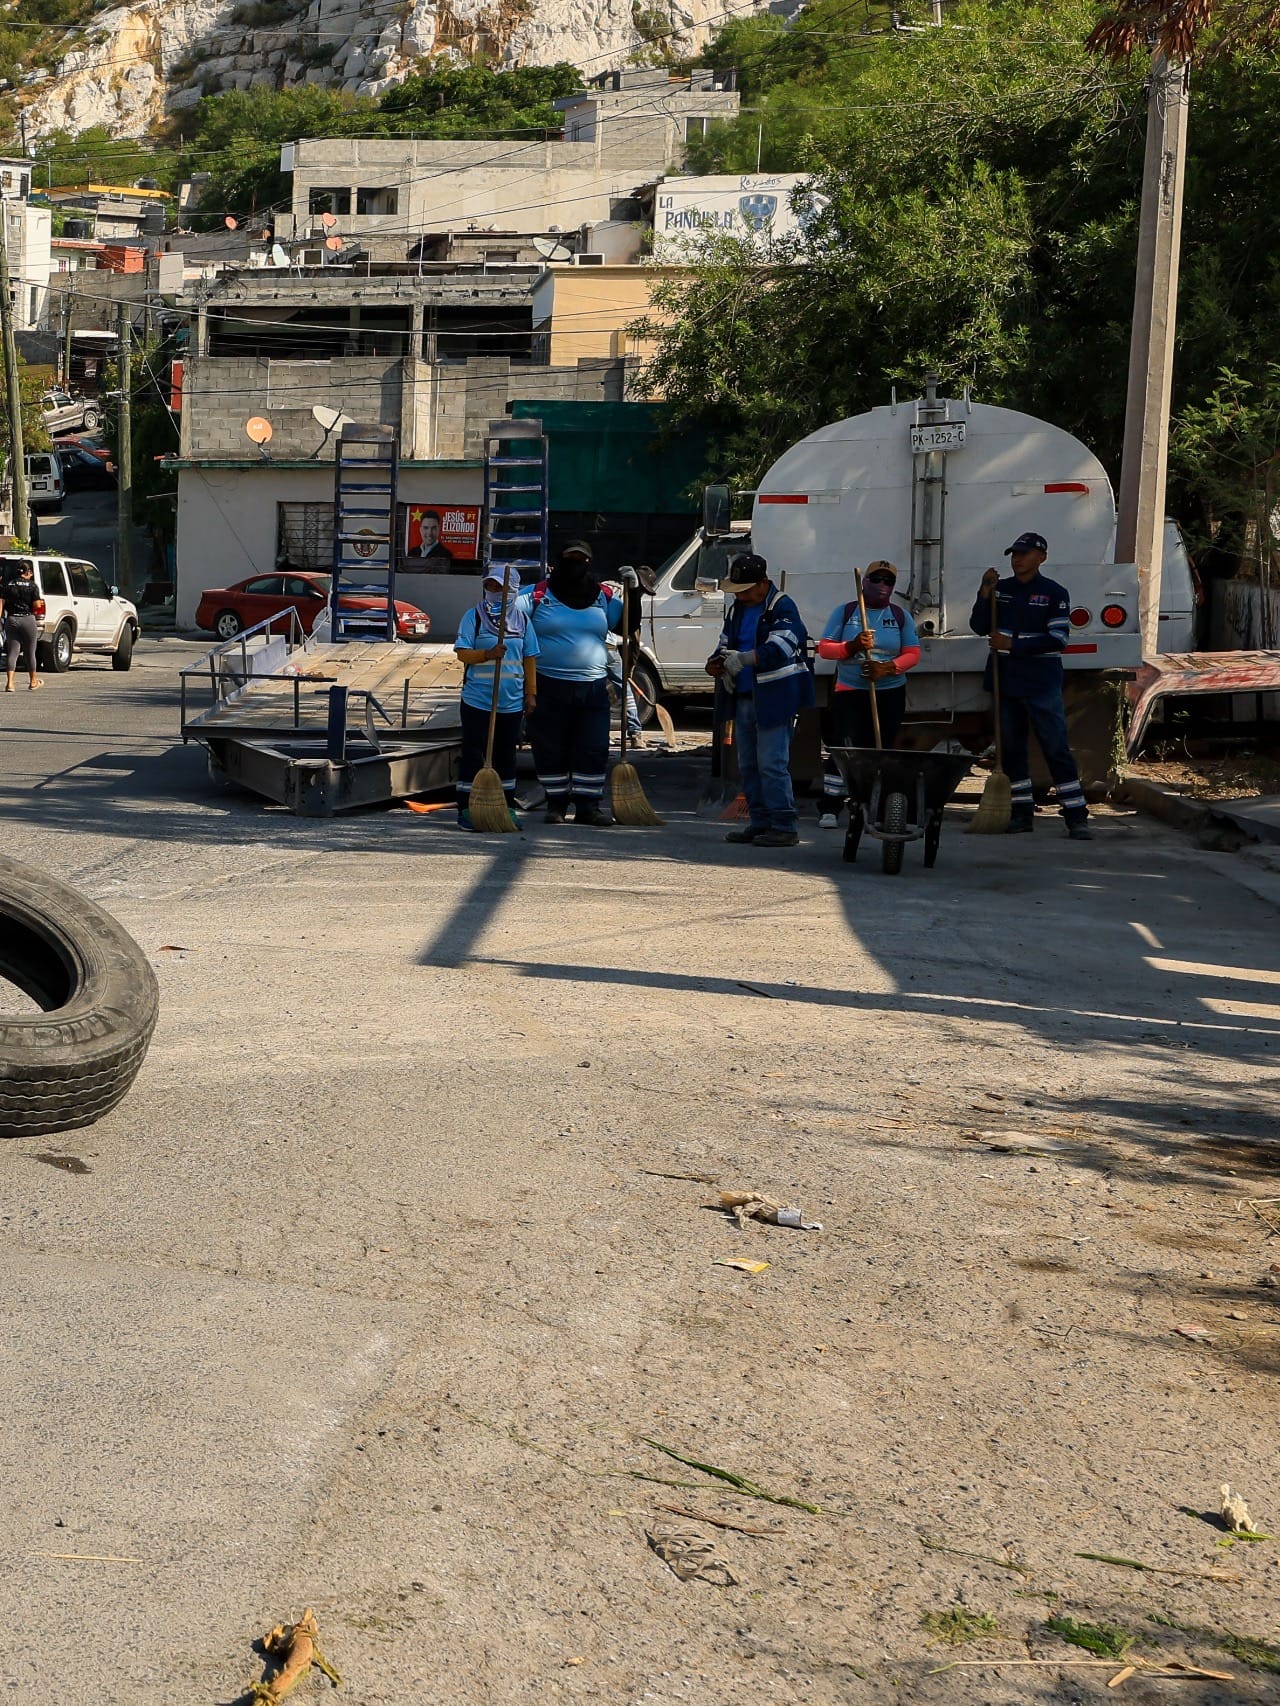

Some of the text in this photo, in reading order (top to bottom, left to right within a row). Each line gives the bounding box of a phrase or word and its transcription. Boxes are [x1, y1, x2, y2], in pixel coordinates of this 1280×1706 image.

[659, 196, 673, 208] LA
[912, 430, 964, 446] PK-1252-C
[442, 510, 465, 522] JESÚS
[442, 521, 475, 533] ELIZONDO
